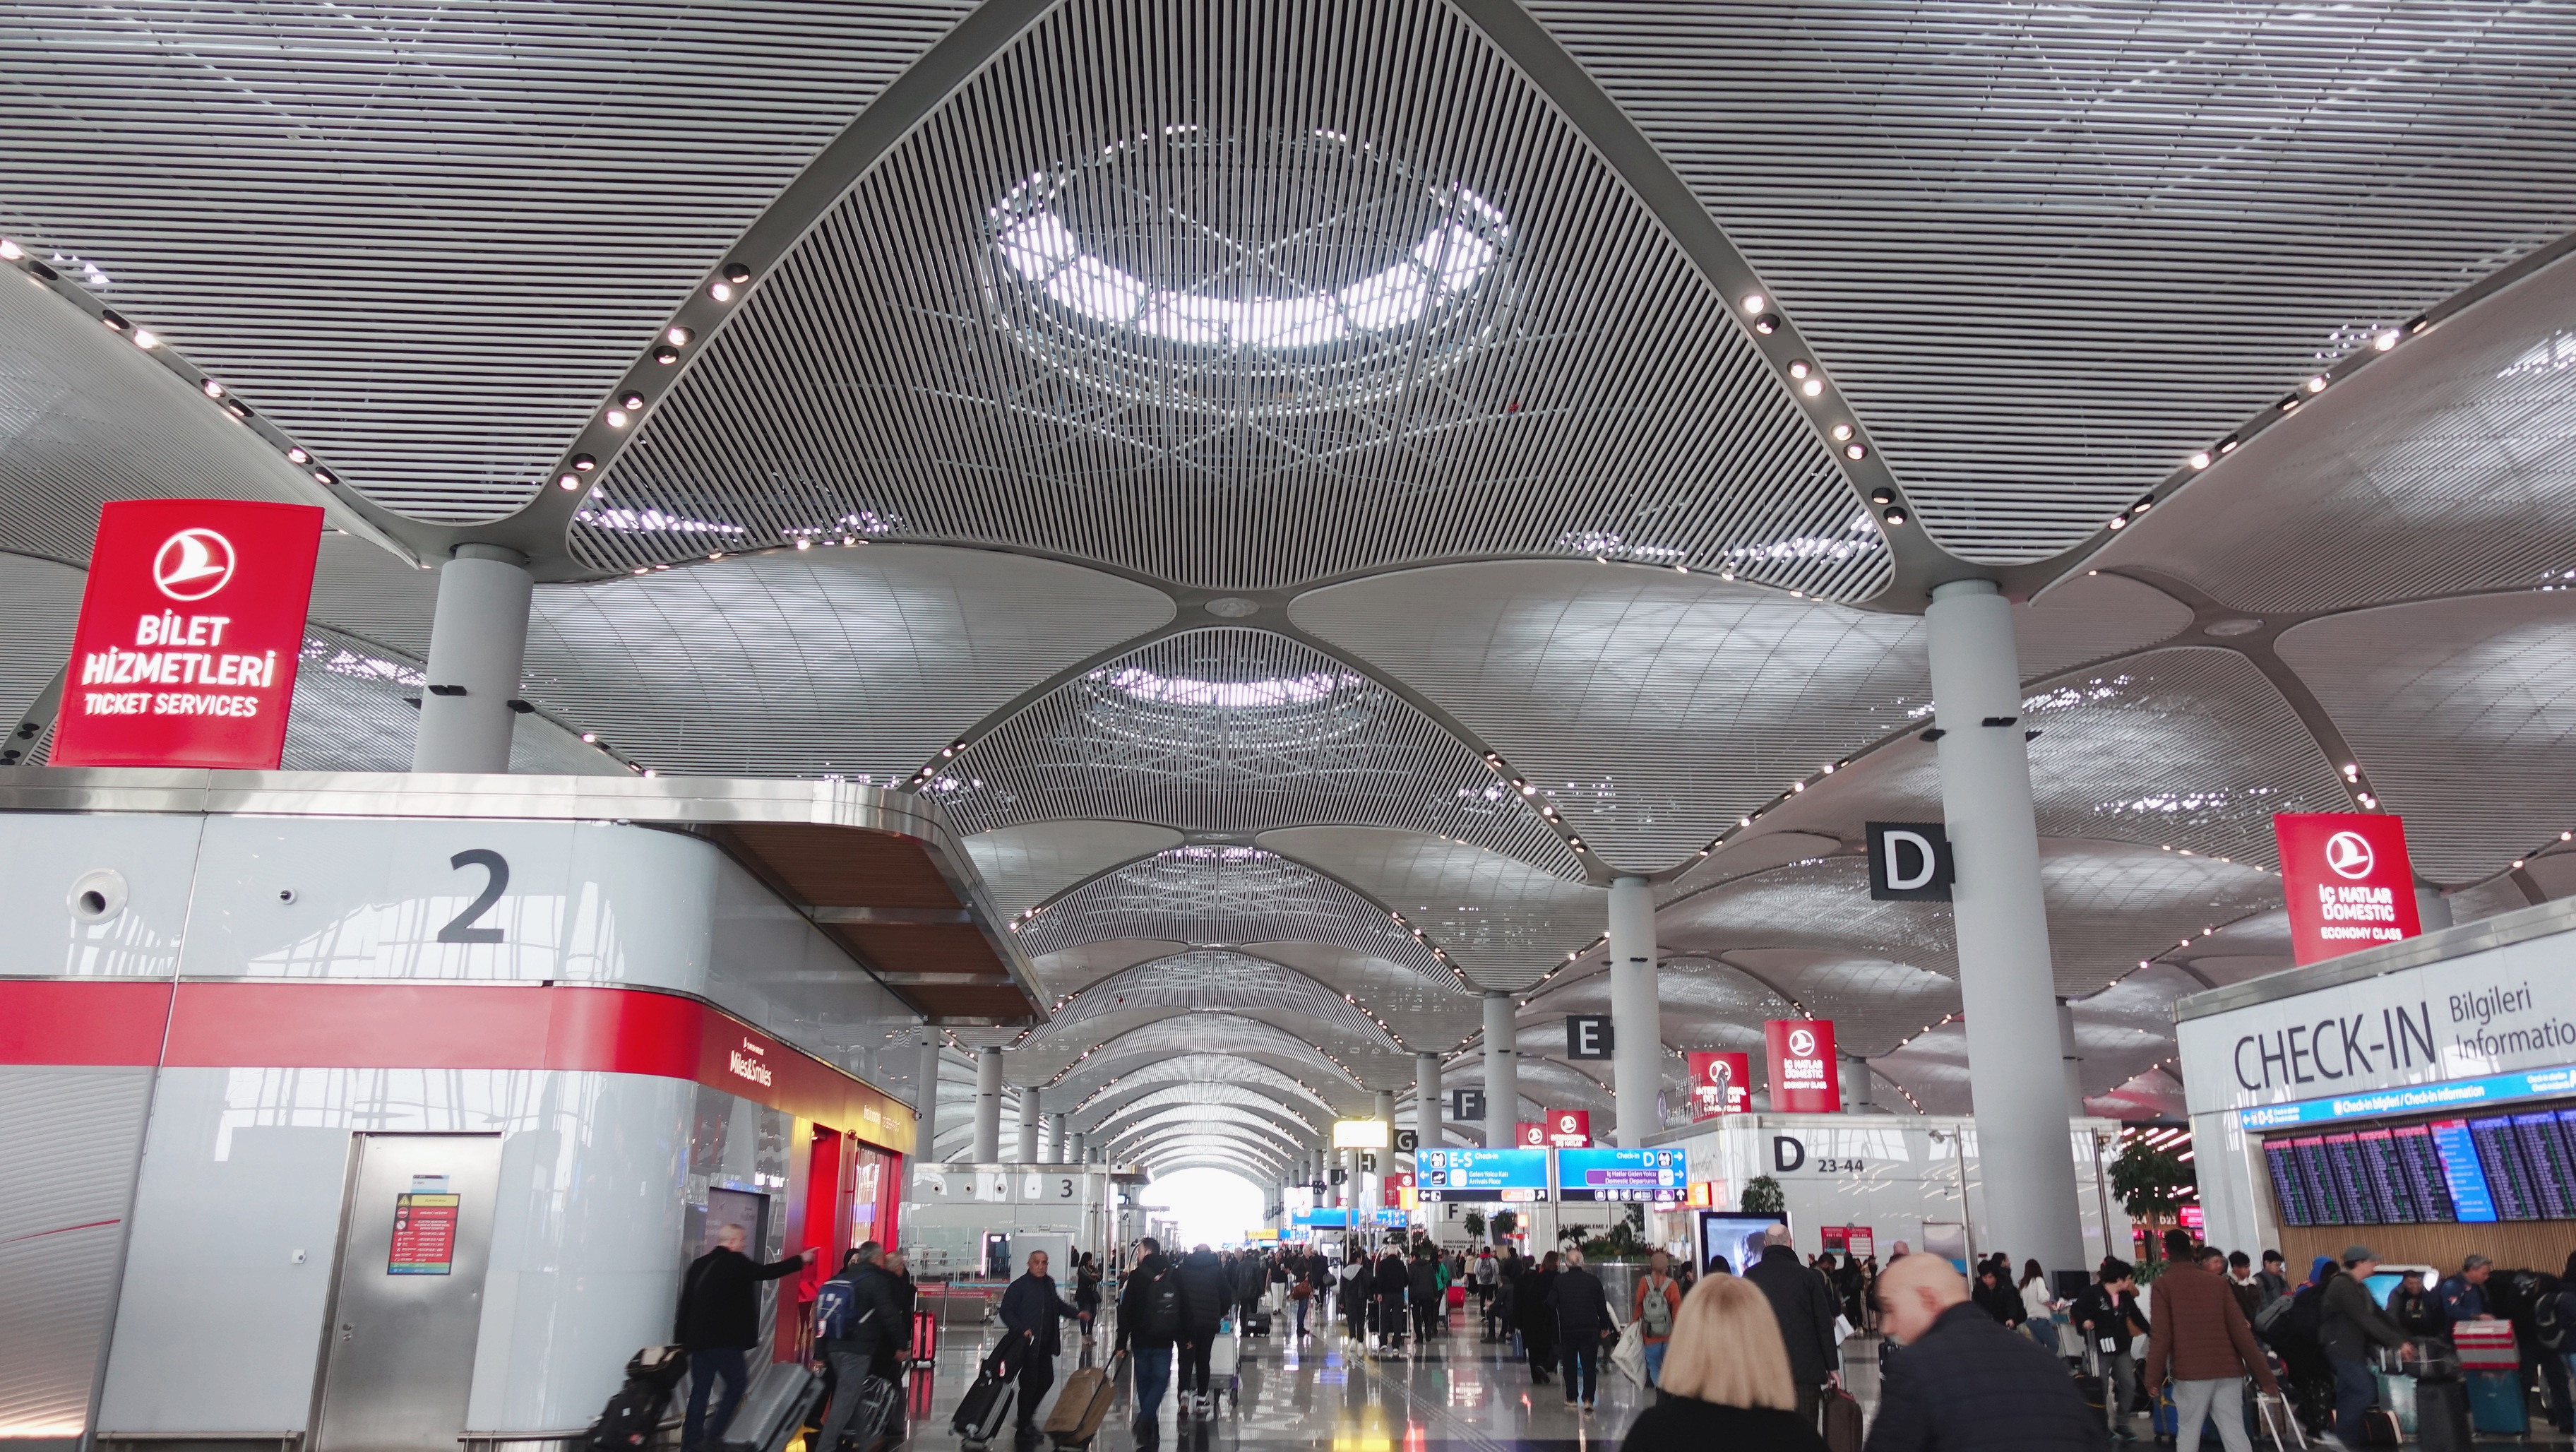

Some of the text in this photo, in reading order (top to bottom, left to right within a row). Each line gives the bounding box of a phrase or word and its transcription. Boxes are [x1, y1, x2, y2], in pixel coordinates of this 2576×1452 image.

[136, 608, 229, 646] BİLET
[80, 645, 275, 688] HİZMETLERİ
[85, 692, 258, 718] TICKET SERVICES
[1883, 831, 1936, 890] D
[437, 849, 509, 944] 2
[2338, 886, 2392, 904] HATLAR
[2322, 904, 2395, 921] DOMESTIC
[2320, 927, 2402, 940] ECONOMY CLASS
[1579, 1020, 1600, 1054] E
[2234, 982, 2532, 1090] CHECK-IN Bilgileri
[730, 1050, 772, 1087] Miles&Smiles
[1785, 1069, 1823, 1078] DOMESTIC
[1462, 1093, 1475, 1117] F
[2343, 1097, 2373, 1114] Check-in
[2373, 1093, 2399, 1111] bilgileri
[2405, 1090, 2438, 1106] Check-in
[2438, 1085, 2485, 1102] information
[2258, 1109, 2274, 1124] D-S
[1397, 1131, 1412, 1150] G
[1450, 1152, 1473, 1167] E-S
[1642, 1152, 1654, 1167] D
[1774, 1136, 1864, 1172] D 23-44
[1335, 1171, 1342, 1184] J
[1061, 1179, 1073, 1198] 3
[1315, 1182, 1323, 1194] K
[1449, 1203, 1458, 1219] F
